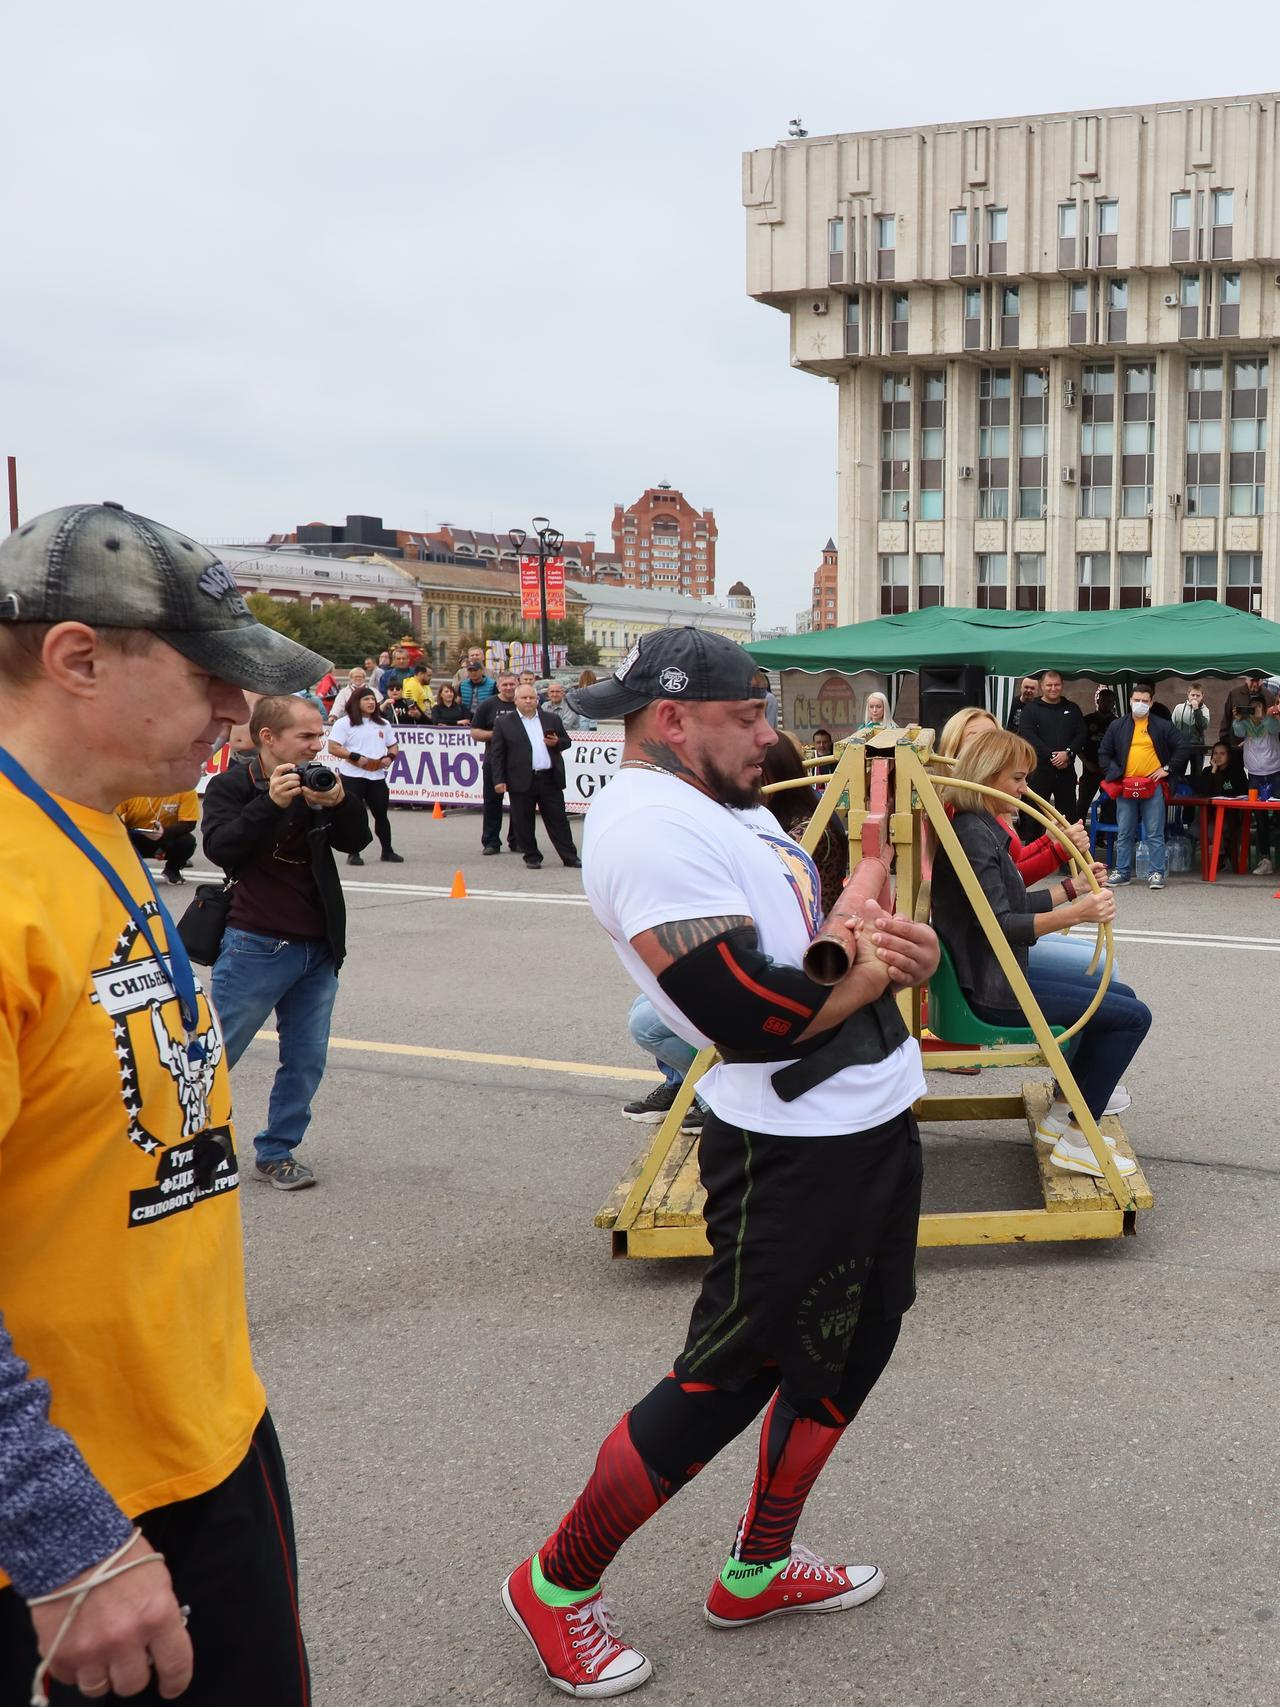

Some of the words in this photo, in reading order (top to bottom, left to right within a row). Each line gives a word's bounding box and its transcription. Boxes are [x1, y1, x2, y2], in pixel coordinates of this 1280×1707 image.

[664, 678, 682, 690] 45
[384, 751, 484, 788] АЛЮ
[388, 789, 419, 798] иколая
[765, 1018, 788, 1034] SBD
[727, 1565, 764, 1580] PUMA
